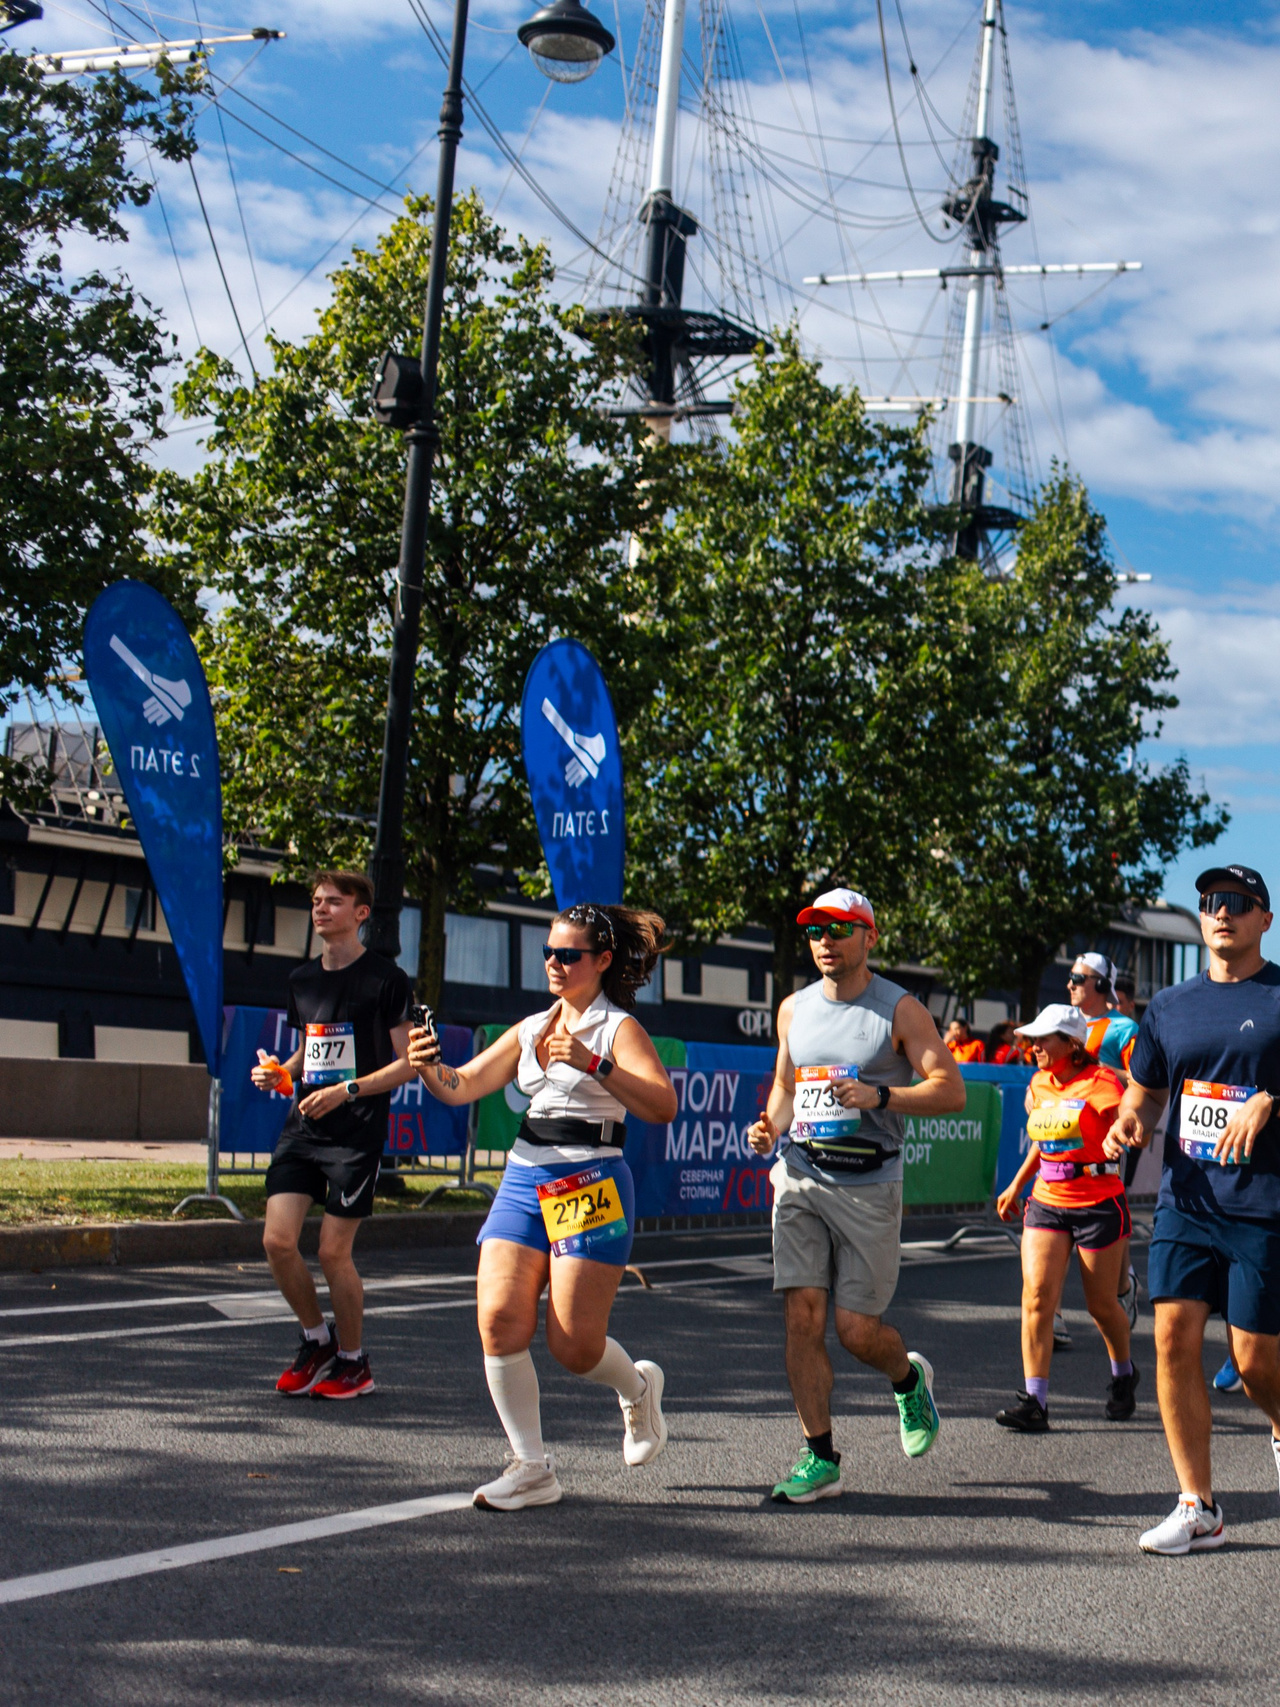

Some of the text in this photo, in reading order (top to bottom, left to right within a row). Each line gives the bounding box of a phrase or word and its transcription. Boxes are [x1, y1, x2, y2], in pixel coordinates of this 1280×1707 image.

[670, 1071, 740, 1113] ПОЛУ
[801, 1087, 844, 1109] 273
[806, 1109, 844, 1117] АЛЕКСАНДР
[1188, 1104, 1229, 1130] 408
[919, 1119, 982, 1140] НОВОСТИ
[1192, 1129, 1220, 1138] ВЛАДИС
[680, 1169, 724, 1184] СЕВЕРНАЯ
[679, 1186, 720, 1200] СТОЛИЦА
[553, 1187, 611, 1225] 2734
[566, 1214, 606, 1231] ЛЮДМИЛА
